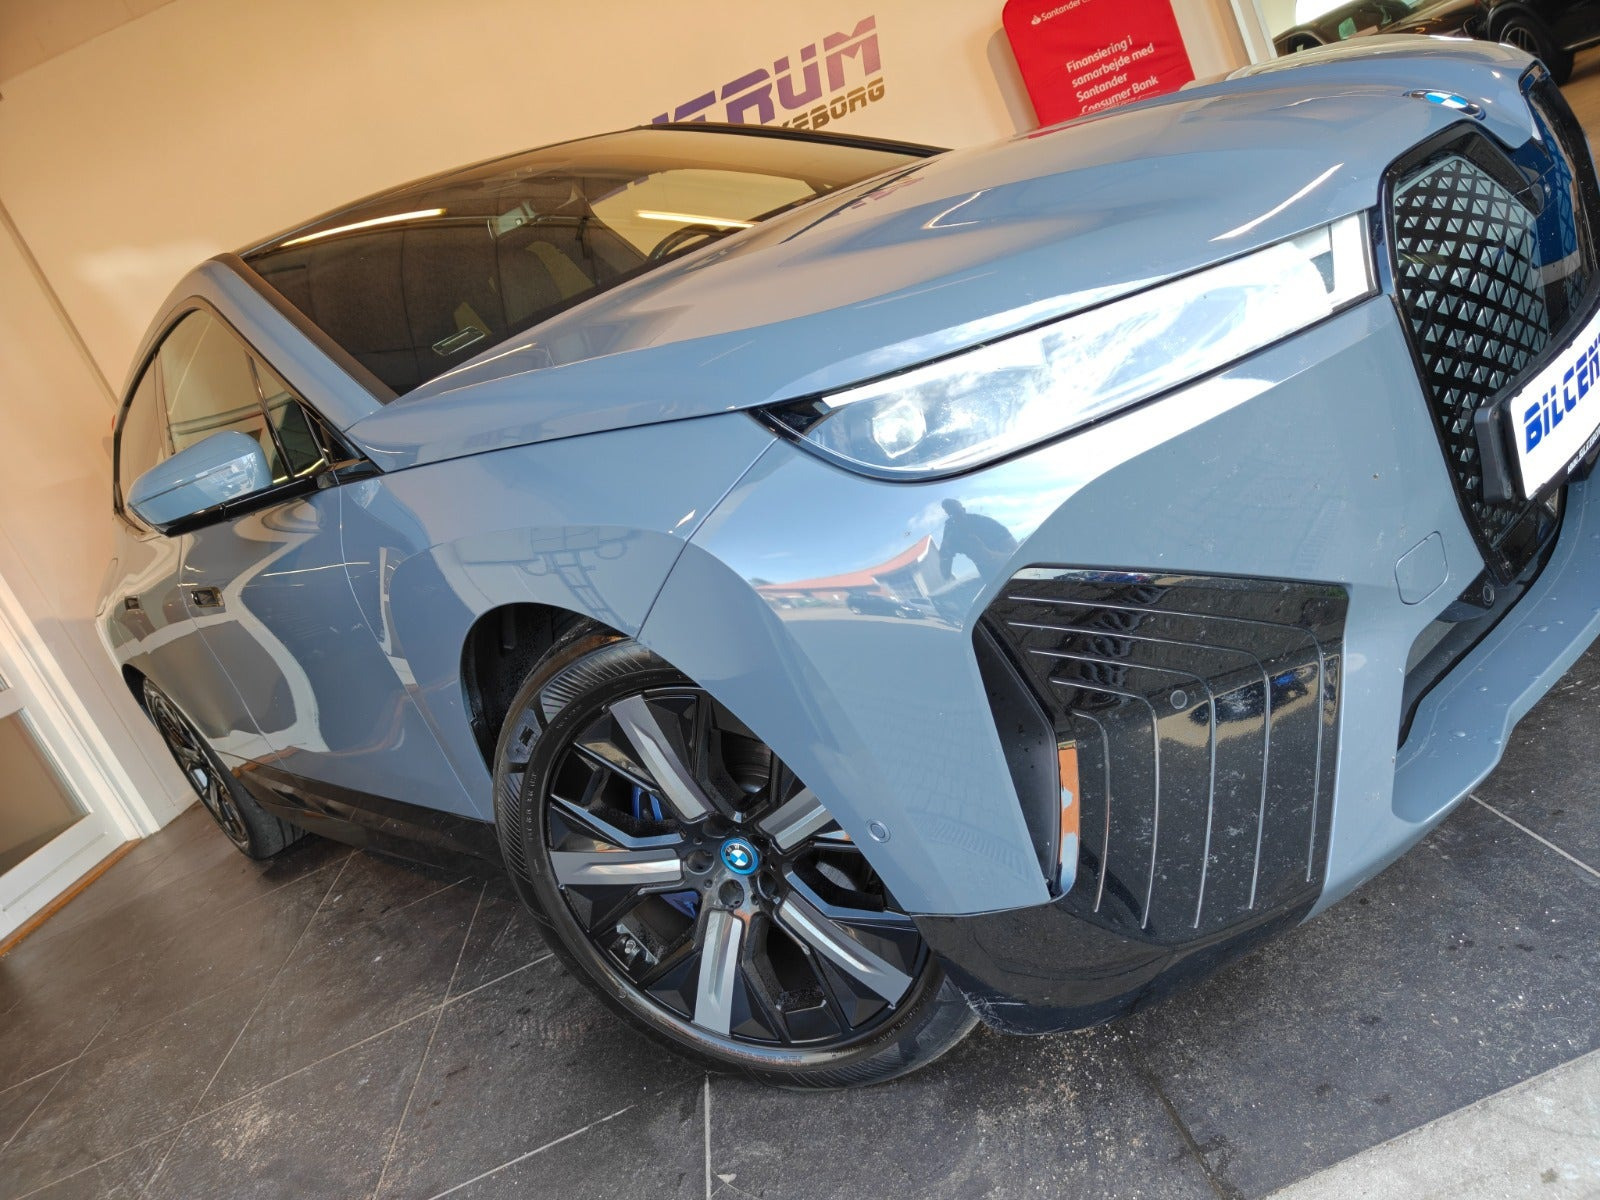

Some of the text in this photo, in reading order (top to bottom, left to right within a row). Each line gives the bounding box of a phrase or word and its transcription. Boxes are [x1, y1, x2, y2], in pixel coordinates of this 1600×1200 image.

[1041, 0, 1081, 21] Santander
[1066, 34, 1133, 73] Finansiering i
[1071, 42, 1155, 88] samarbejde med
[1076, 73, 1128, 102] Santander
[1131, 75, 1159, 94] Bank
[1523, 332, 1600, 454] BILCEN
